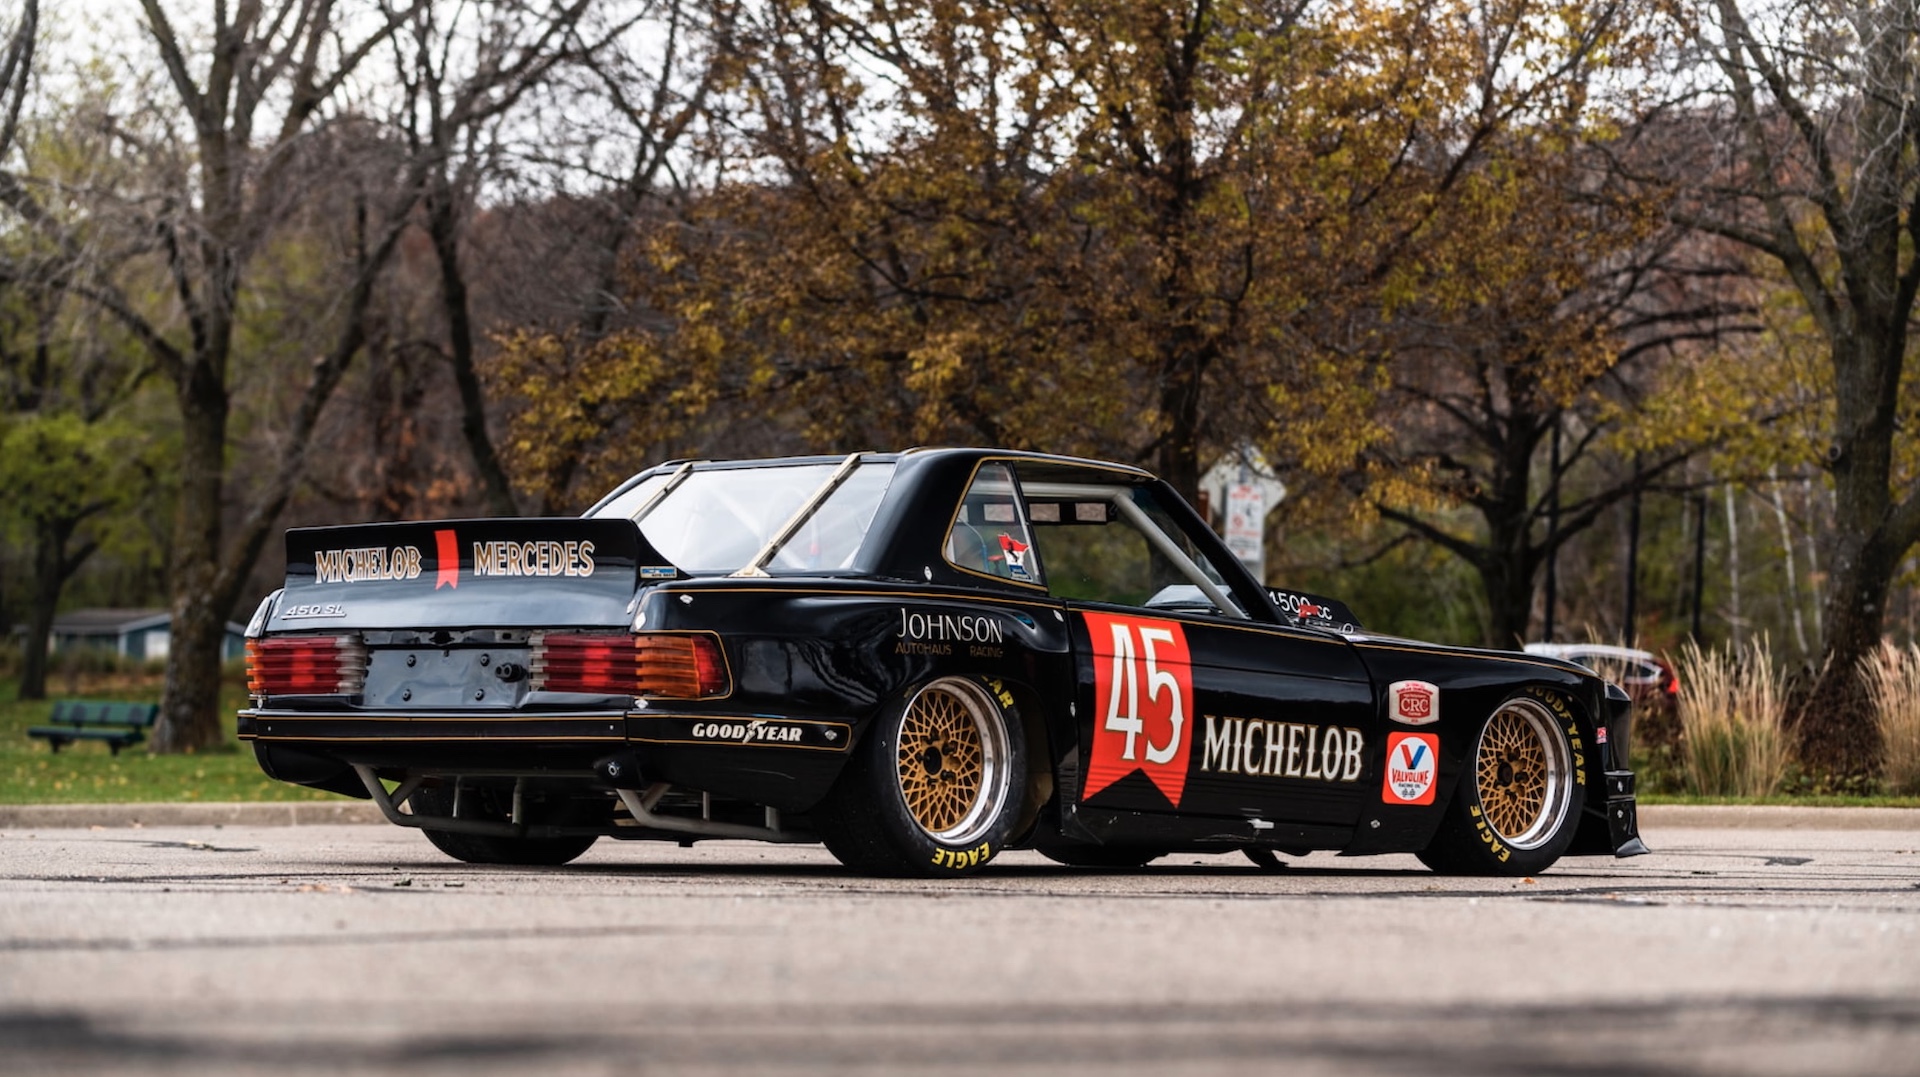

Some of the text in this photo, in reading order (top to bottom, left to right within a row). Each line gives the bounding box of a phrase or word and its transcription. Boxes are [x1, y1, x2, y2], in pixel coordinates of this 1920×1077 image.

[314, 540, 595, 583] MICHELOB MERCEDES
[286, 605, 343, 615] 450 SL
[896, 607, 1003, 644] JOHNSON
[895, 642, 1003, 657] AUTOHAUS RACING
[1105, 622, 1184, 764] 45
[1400, 697, 1429, 713] CRC
[1201, 715, 1364, 782] MICHELOB
[1392, 768, 1429, 786] VALVOLINE
[1470, 804, 1511, 863] EAGLE
[931, 841, 990, 870] EAGLE
